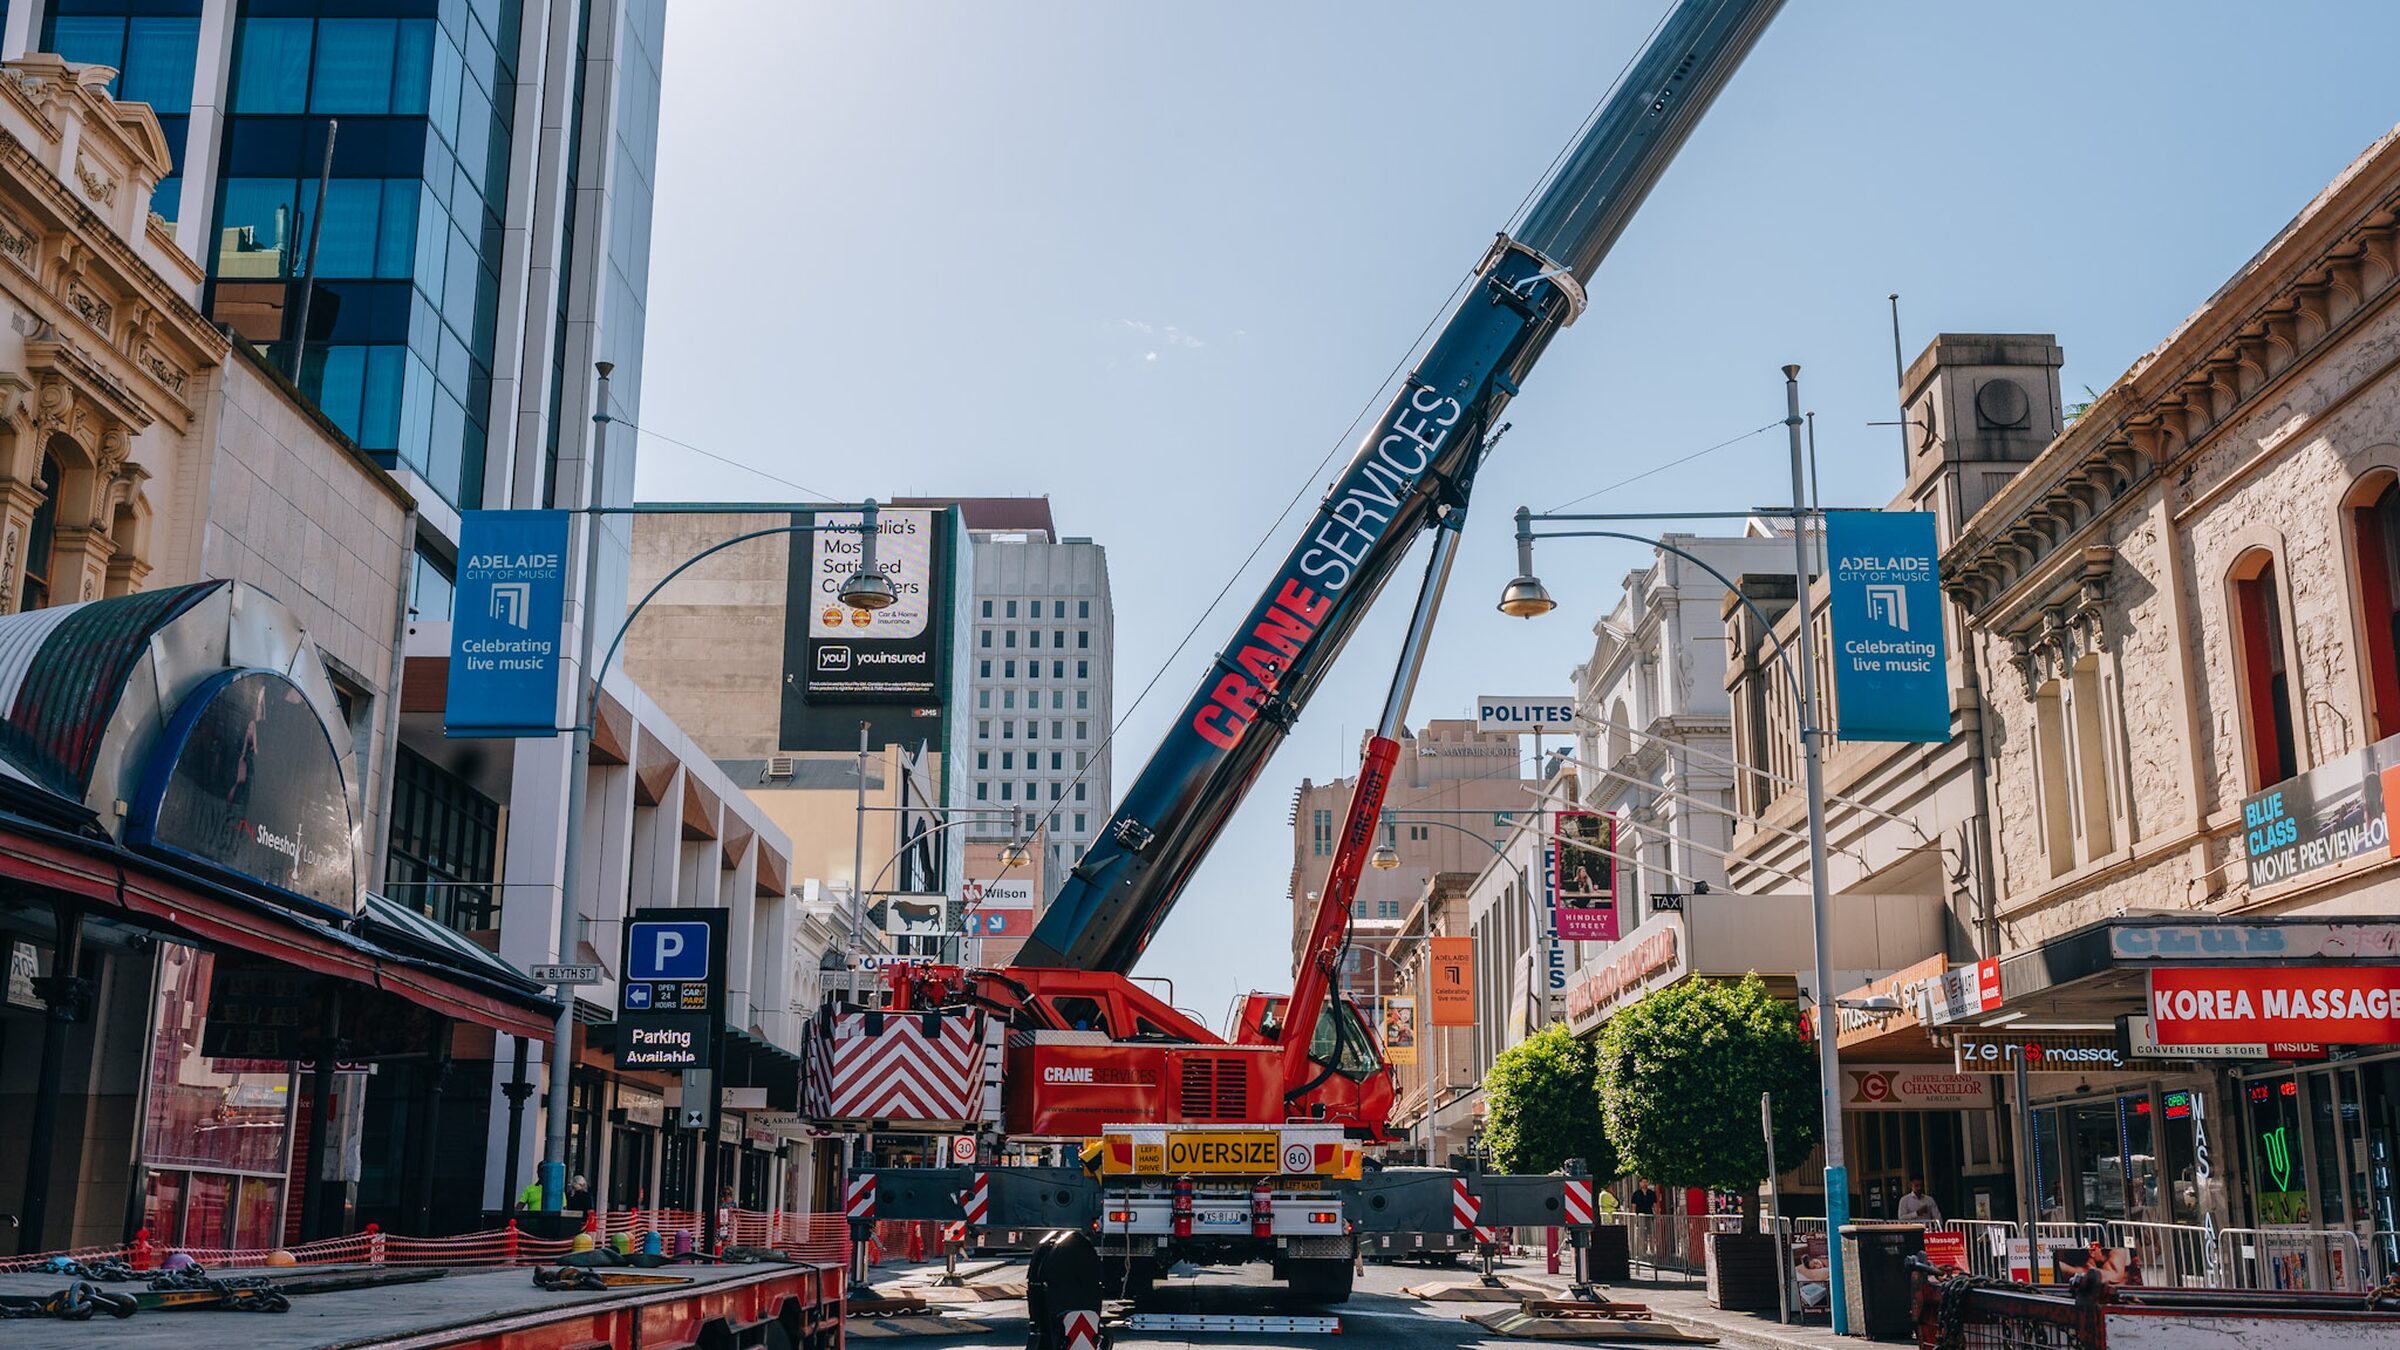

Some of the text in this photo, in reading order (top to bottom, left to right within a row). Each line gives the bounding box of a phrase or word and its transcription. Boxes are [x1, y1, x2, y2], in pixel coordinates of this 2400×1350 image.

[824, 518, 916, 535] Austalia's
[468, 554, 558, 569] ADELAIDE
[1193, 385, 1461, 750] CRANE SERVICES
[1839, 557, 1930, 571] ADELAIDE
[466, 569, 557, 580] CITY OF MUSIC
[1839, 572, 1930, 582] CITY OF MUSIC
[462, 639, 552, 656] Celebrating
[1845, 640, 1936, 658] Celebrating
[467, 656, 544, 671] live music
[822, 650, 847, 667] youi
[1853, 657, 1931, 672] live music
[1481, 706, 1573, 722] POLITES
[2246, 792, 2285, 829] BLUE
[2249, 817, 2298, 857] CLASS
[2252, 848, 2298, 886] MOVIE
[2299, 825, 2361, 870] PREVIEW
[984, 888, 1028, 900] Wilson
[1653, 895, 1682, 909] TAXI
[1565, 913, 1609, 921] HINDLEY
[1569, 922, 1606, 930] STREET
[655, 931, 684, 972] P
[548, 968, 592, 979] BLYTH ST
[657, 983, 676, 992] OPEN
[660, 992, 671, 1000] 24
[654, 1001, 677, 1009] HOURS
[2154, 988, 2400, 1021] KOREA MASSAGE
[631, 1029, 692, 1048] Parking
[2136, 1043, 2264, 1056] CONVENIENCE STORE
[1043, 1066, 1157, 1084] CRANE SERVICES
[1912, 1074, 1972, 1083] HOTEL GRAND
[1901, 1080, 1983, 1095] CHANCELLOR
[2167, 1095, 2186, 1107] OPEN
[958, 1143, 972, 1154] 30
[1140, 1146, 1158, 1154] LEFT
[1171, 1142, 1276, 1164] OVERSIZE
[1138, 1155, 1160, 1163] HAND
[1288, 1153, 1306, 1165] 80
[1138, 1164, 1161, 1172] DRIVE
